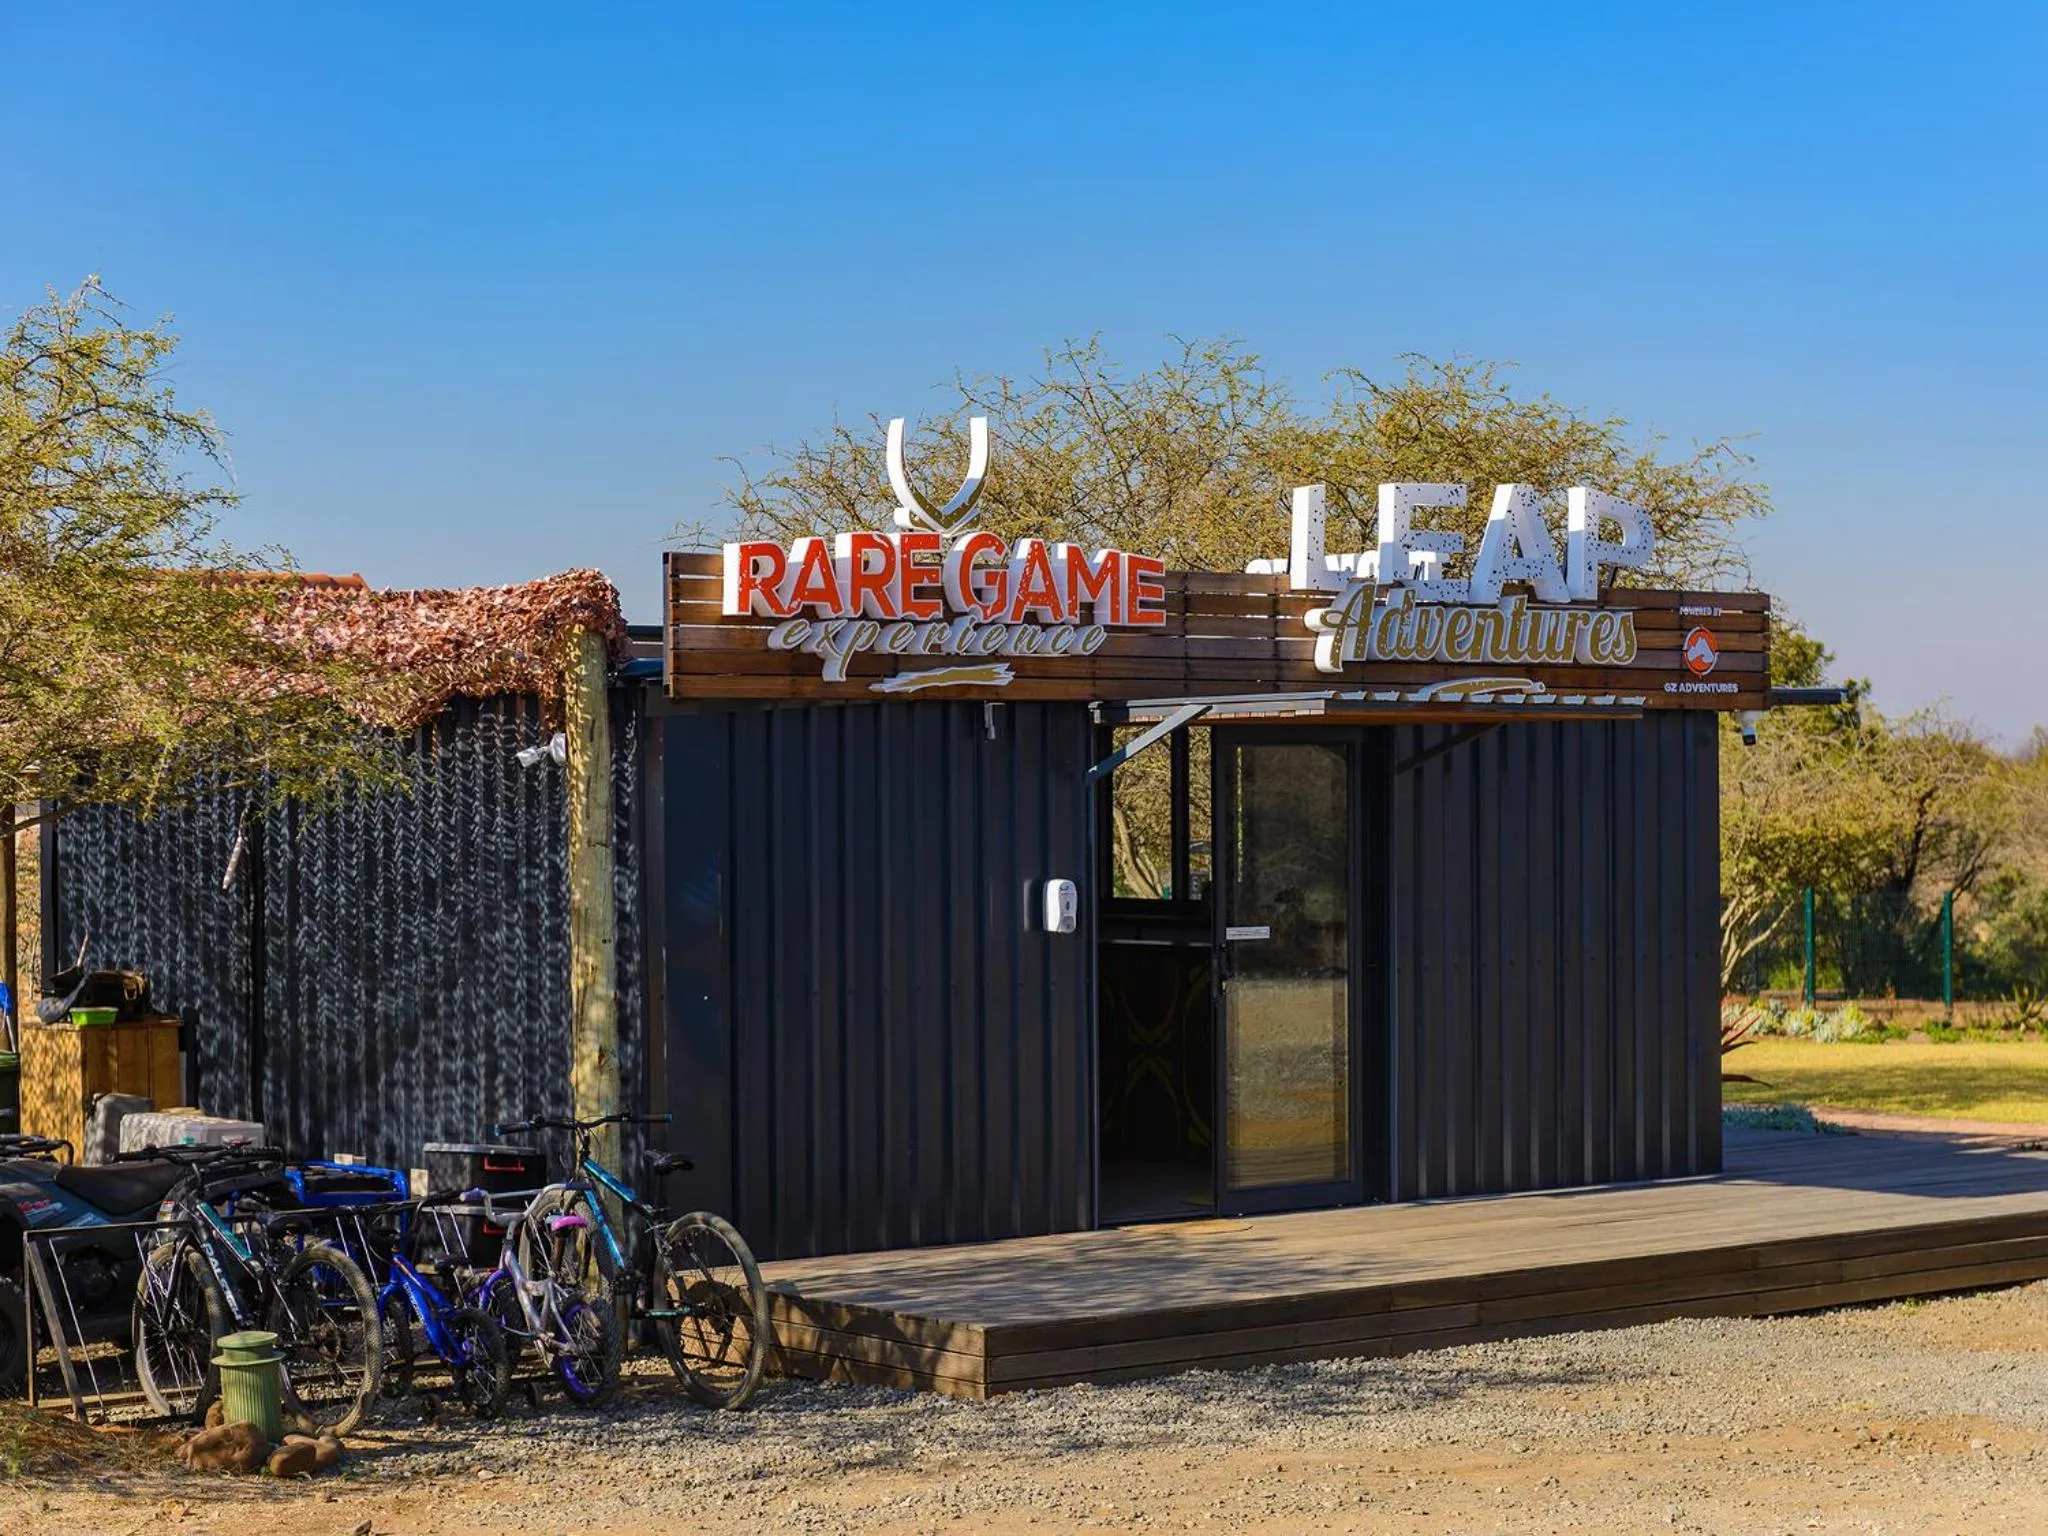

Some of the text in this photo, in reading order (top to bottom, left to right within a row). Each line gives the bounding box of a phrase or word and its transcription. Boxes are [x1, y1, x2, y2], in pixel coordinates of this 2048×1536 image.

[722, 531, 945, 620] RARE
[1290, 482, 1656, 603] LEAP
[767, 617, 1108, 682] experience
[1304, 582, 1637, 674] Adventures
[1664, 682, 1738, 693] GZ ADVENTURES
